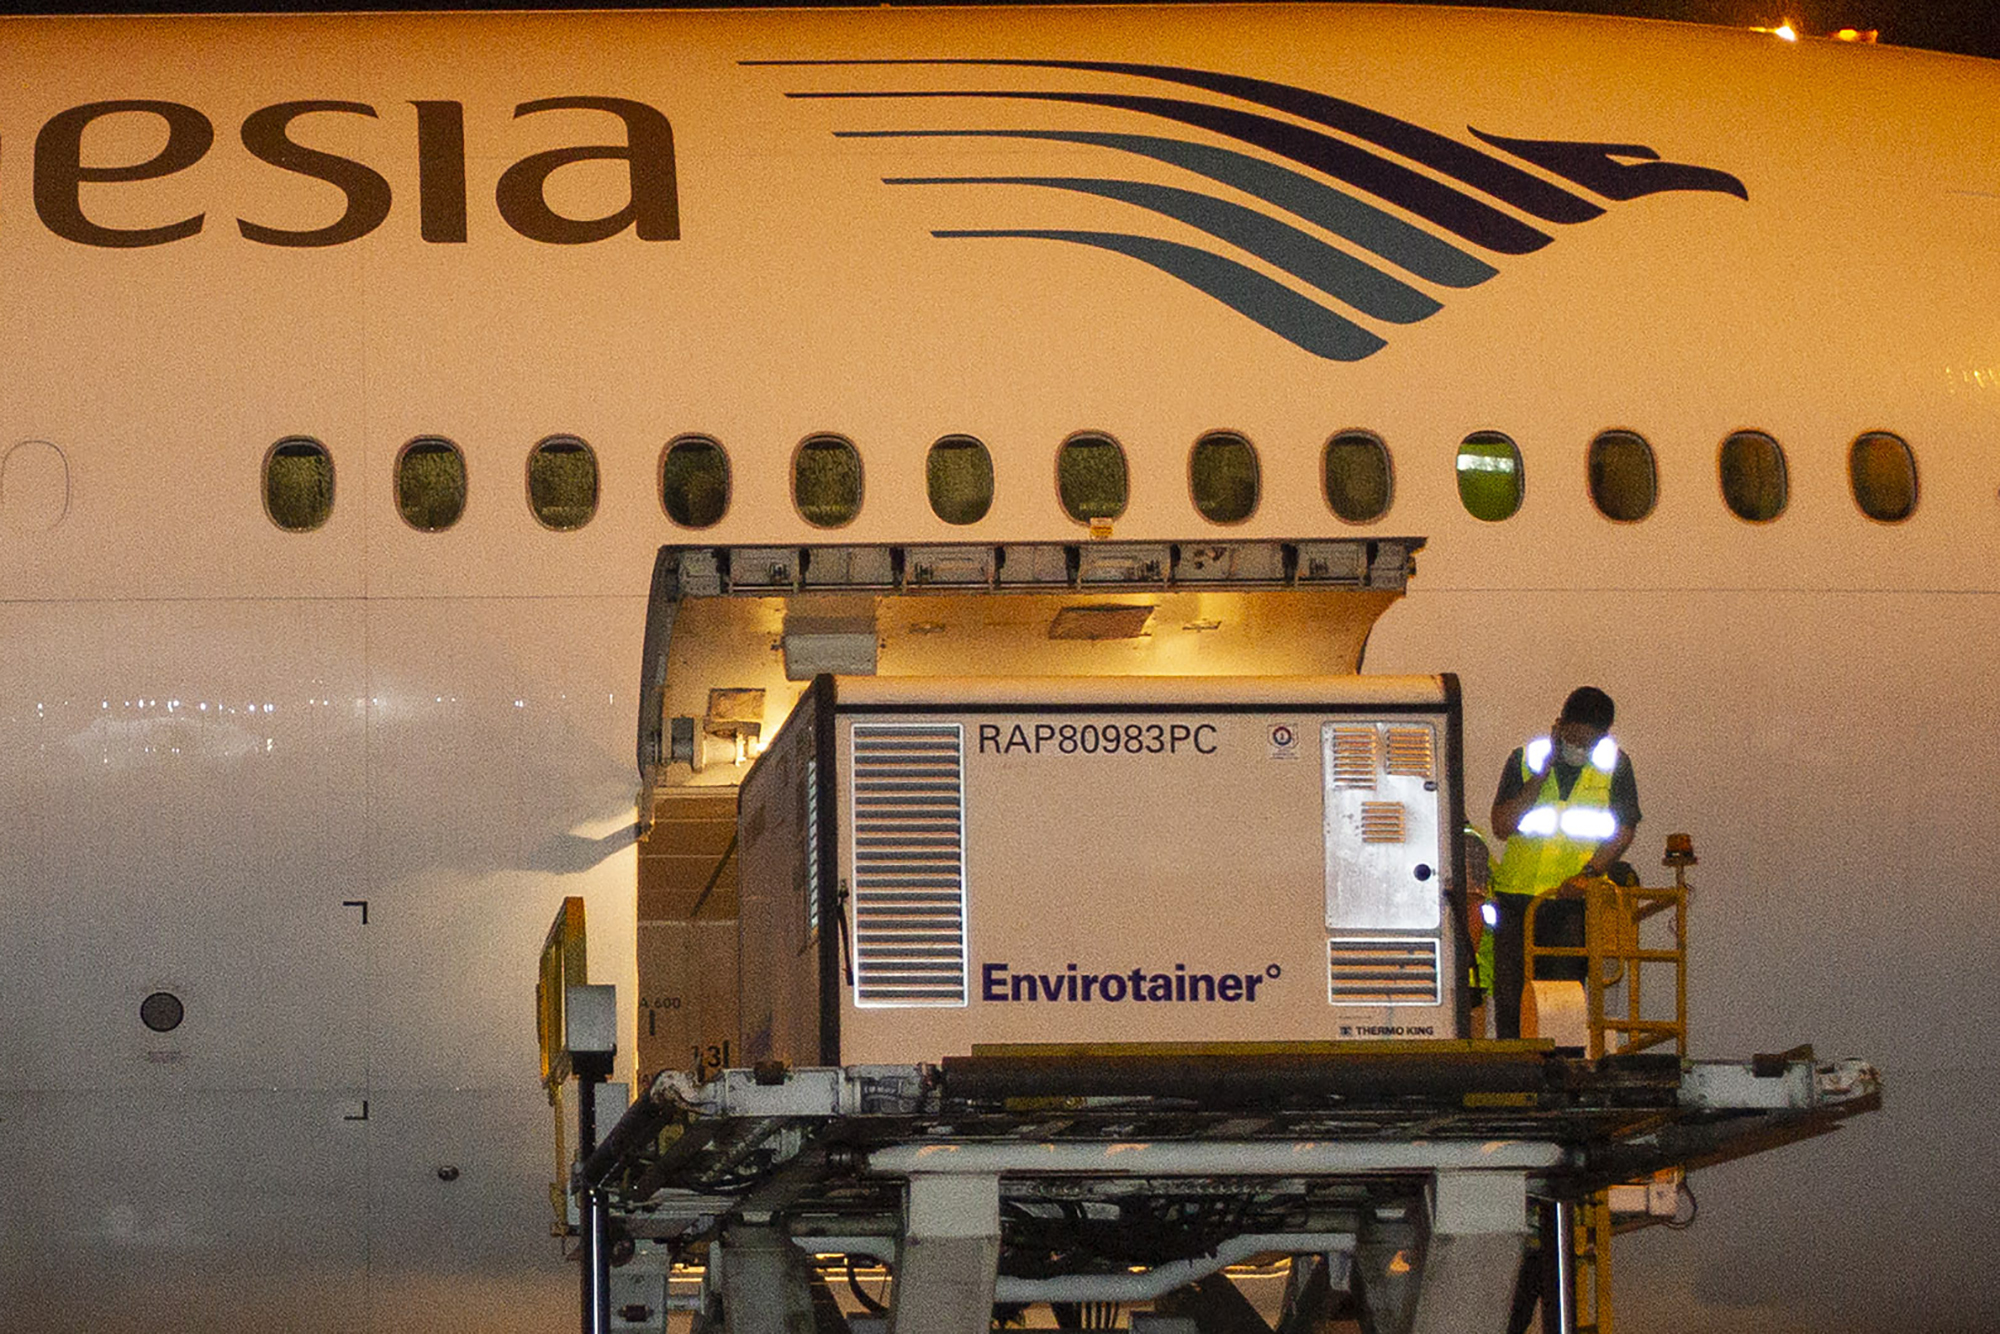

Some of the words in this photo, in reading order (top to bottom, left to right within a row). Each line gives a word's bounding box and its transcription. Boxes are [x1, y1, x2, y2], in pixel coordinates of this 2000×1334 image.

[978, 723, 1218, 754] RAP80983PC
[1356, 1025, 1405, 1036] THERMO
[1406, 1025, 1435, 1036] KING
